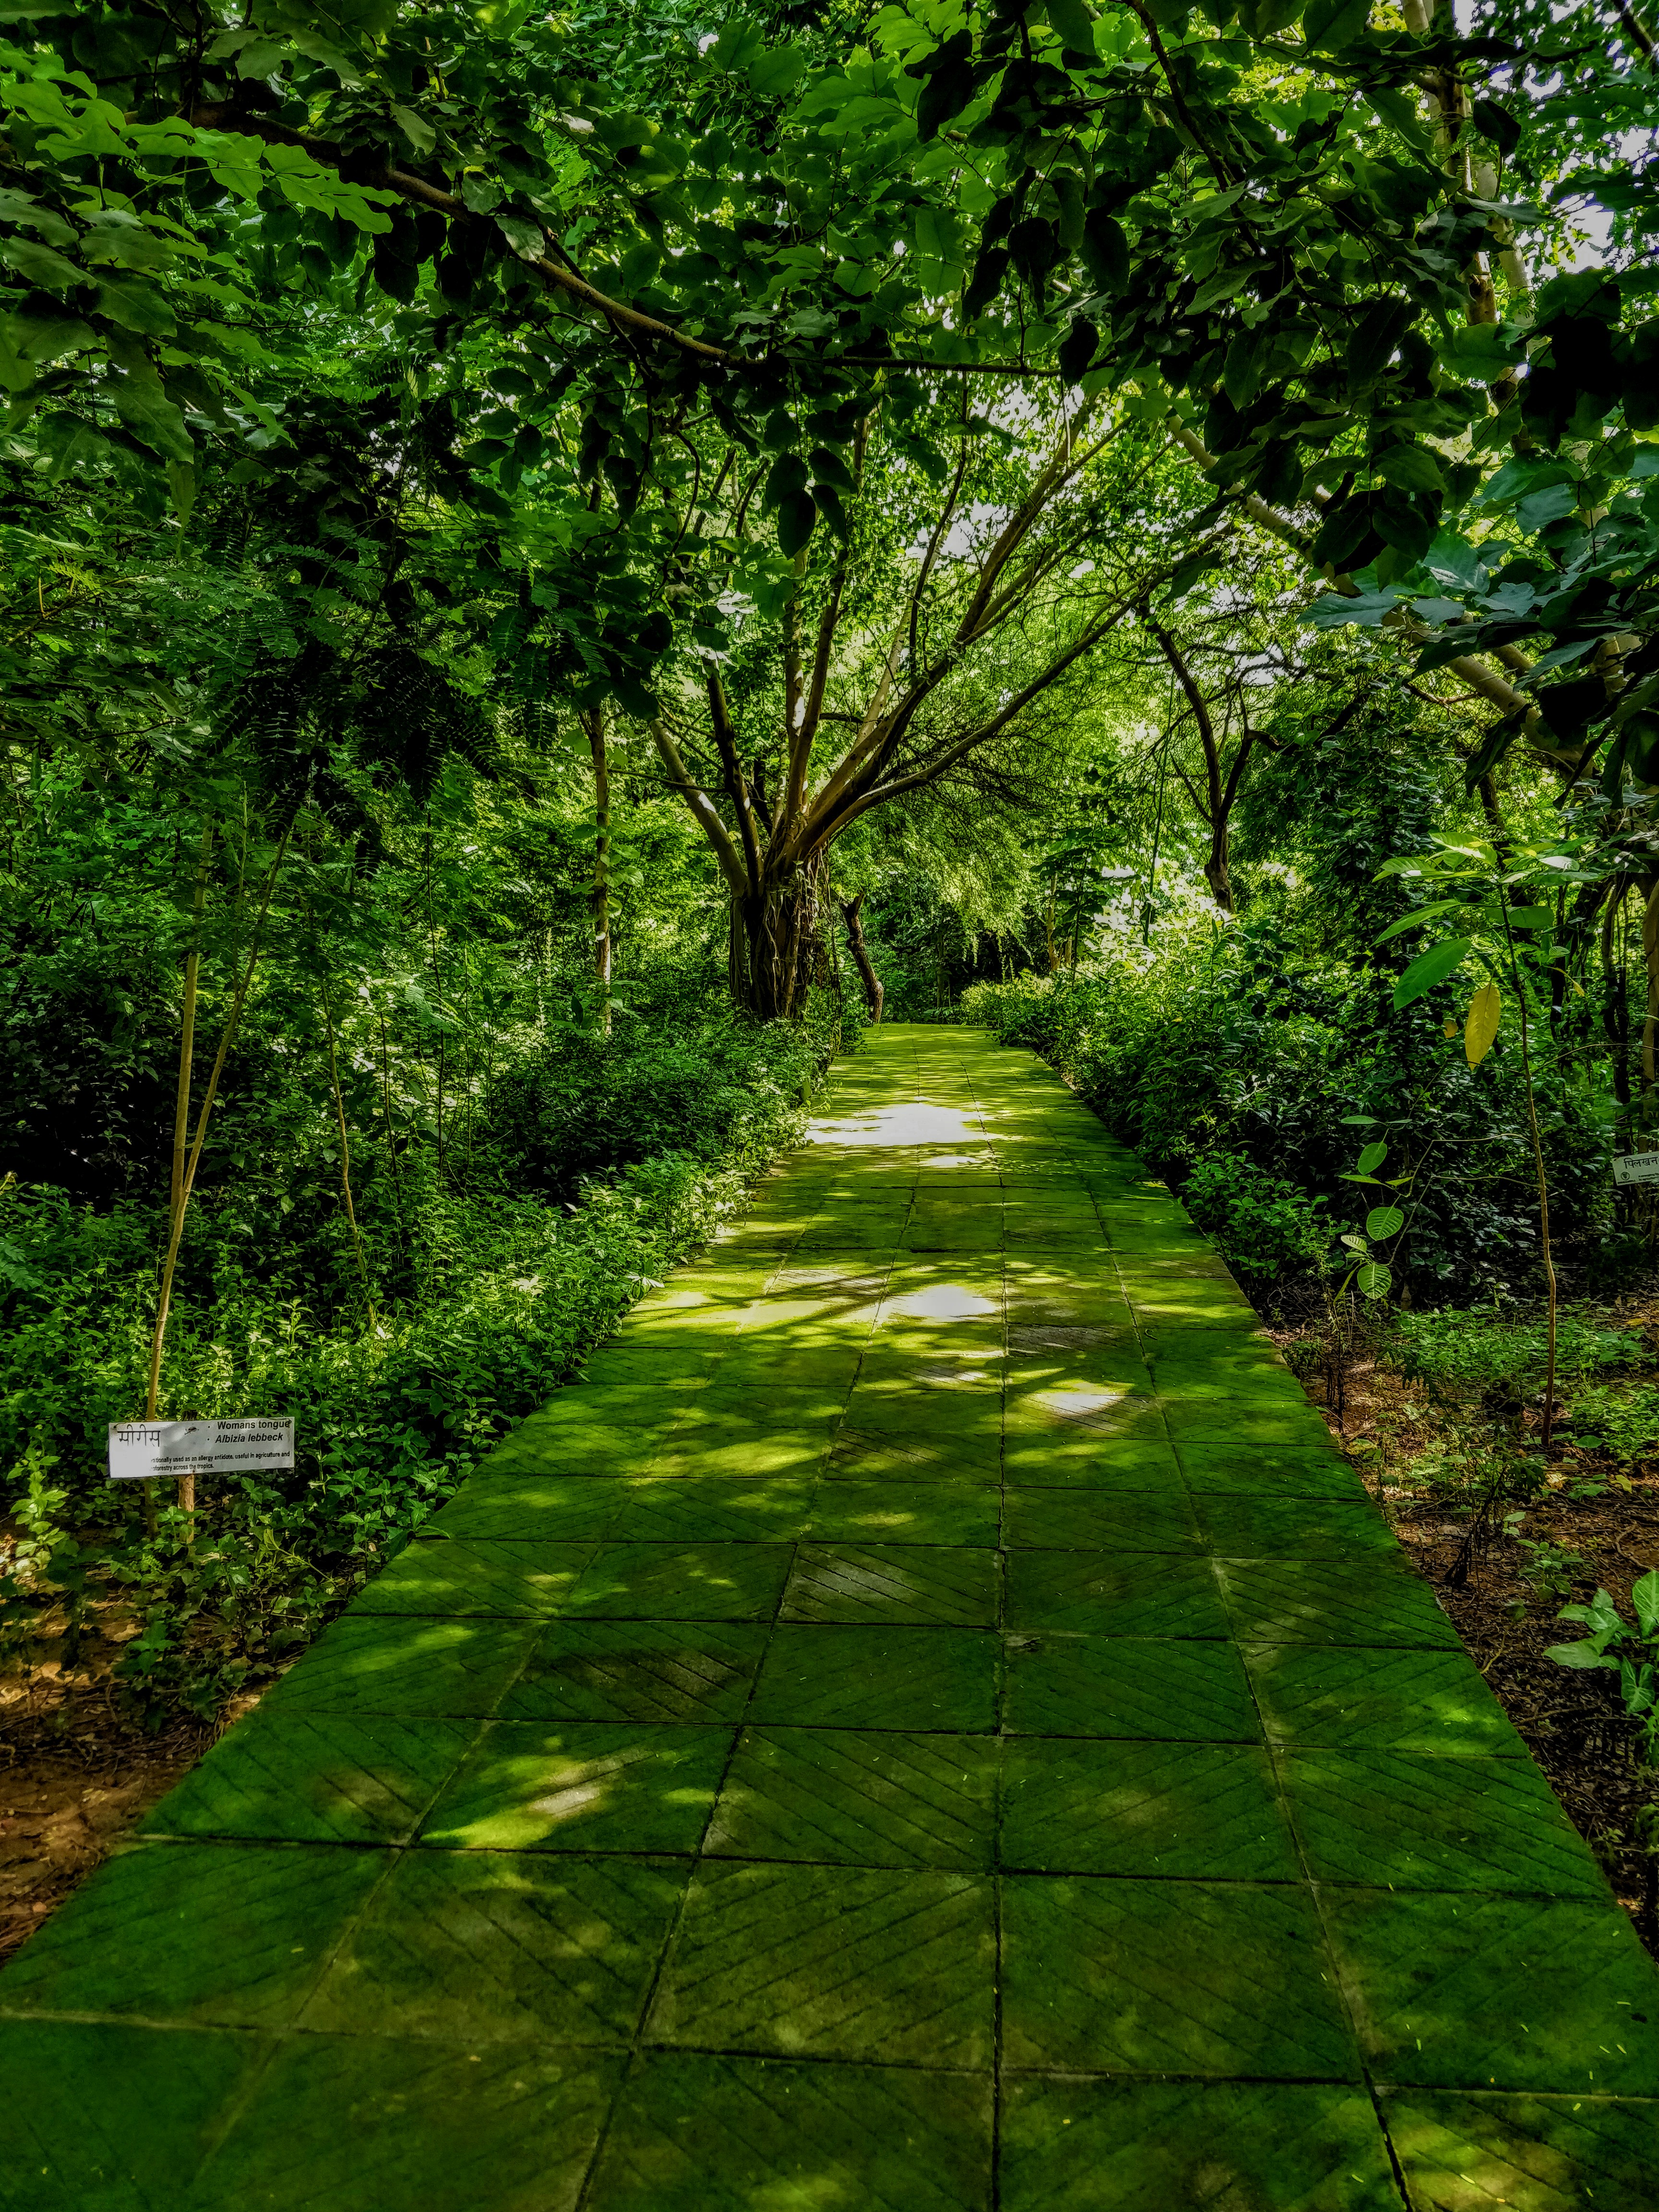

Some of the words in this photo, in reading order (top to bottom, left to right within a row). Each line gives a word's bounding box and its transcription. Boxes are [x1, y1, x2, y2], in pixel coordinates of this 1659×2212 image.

[1623, 1156, 1658, 1169] पिलखन
[217, 1421, 255, 1430] Womans
[259, 1420, 290, 1430] tongue
[215, 1434, 245, 1443] Albizia
[248, 1432, 284, 1442] lebbeck
